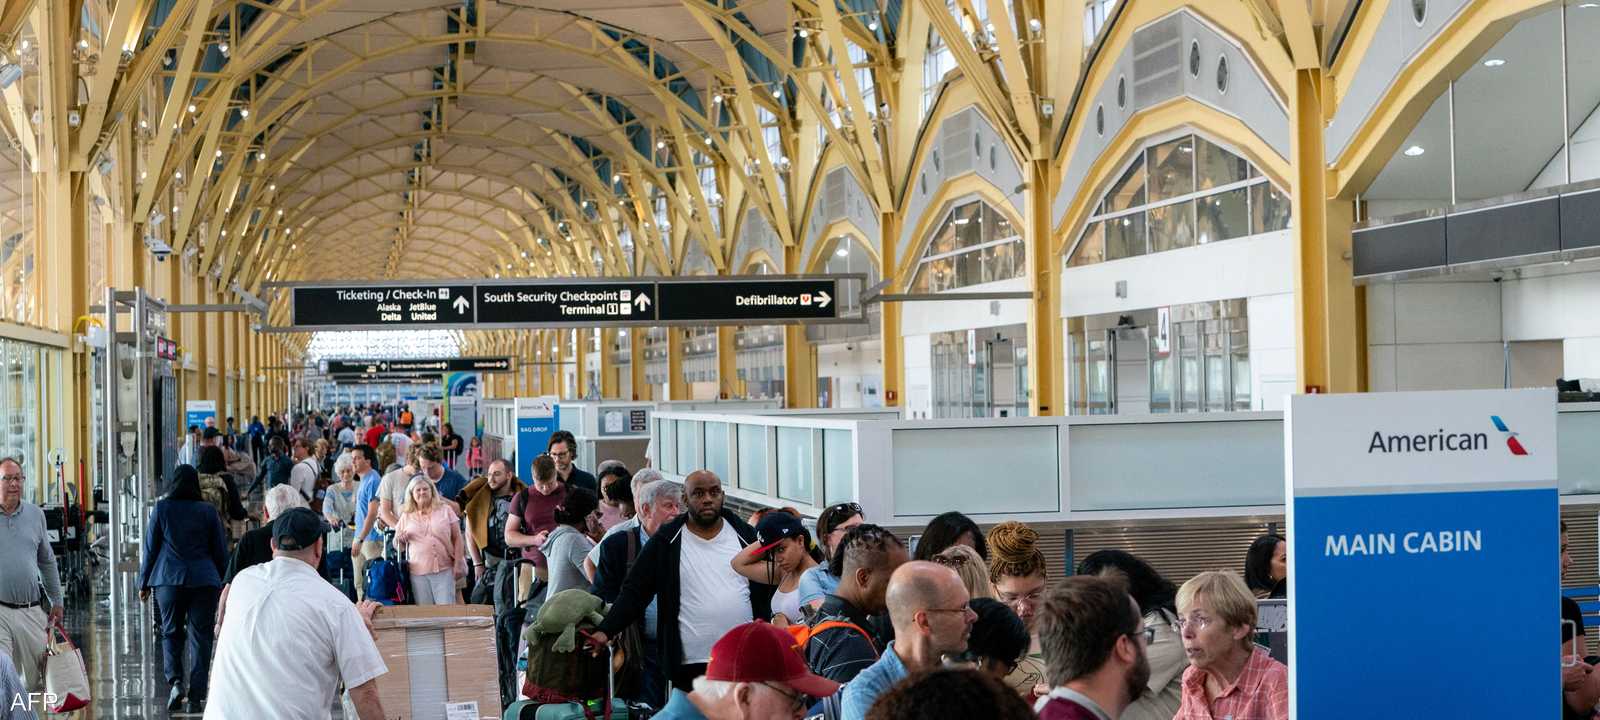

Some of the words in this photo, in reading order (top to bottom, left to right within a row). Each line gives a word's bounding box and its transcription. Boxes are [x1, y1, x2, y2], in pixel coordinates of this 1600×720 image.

[336, 290, 384, 302] Ticketing
[386, 290, 391, 300] /
[392, 289, 437, 300] Check-In
[483, 291, 515, 303] South
[516, 291, 558, 304] Security
[559, 290, 618, 303] Checkpoint
[735, 294, 799, 306] Defibrillator
[376, 303, 402, 312] Alaska
[408, 302, 437, 312] JetBlue
[559, 304, 606, 315] Terminal
[380, 312, 402, 321] Delta
[410, 311, 437, 321] United
[1367, 428, 1488, 454] American
[1324, 532, 1396, 557] MAIN
[1402, 529, 1482, 554] CABIN
